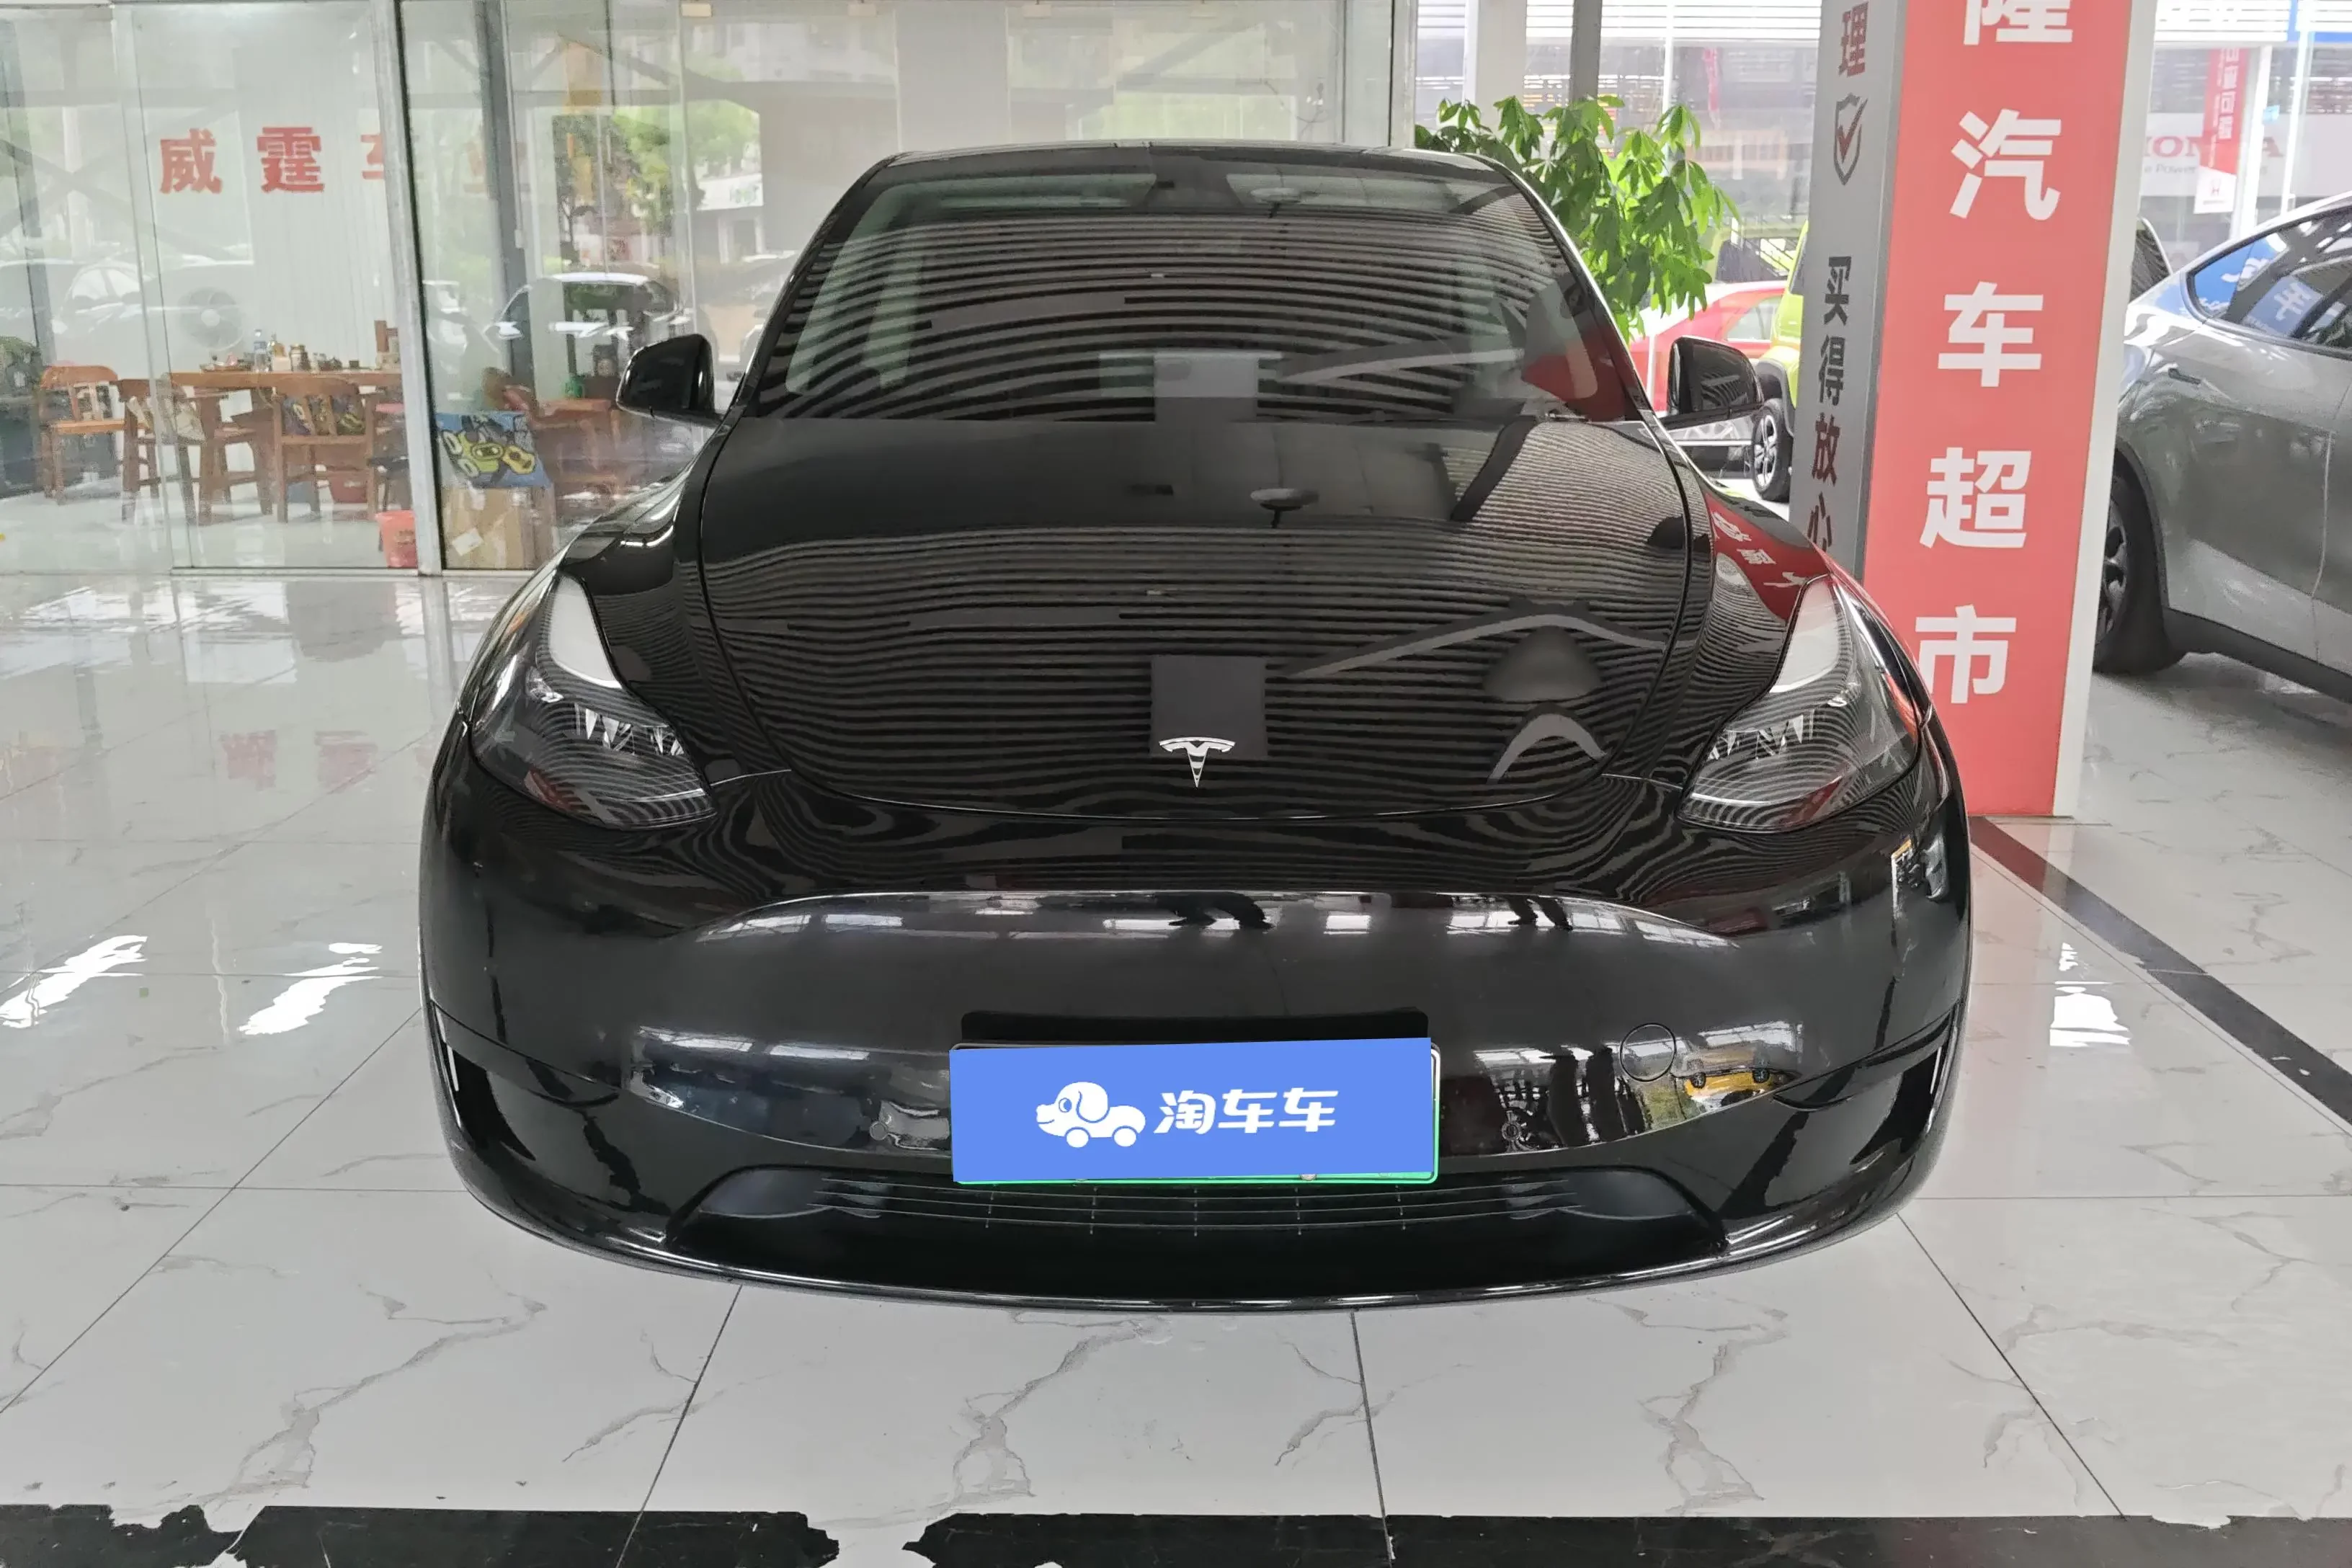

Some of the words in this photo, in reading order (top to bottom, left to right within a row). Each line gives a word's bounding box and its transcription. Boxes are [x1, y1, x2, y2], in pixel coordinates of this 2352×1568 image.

[1838, 1, 1868, 78] 理
[1807, 256, 1852, 552] 买得放心
